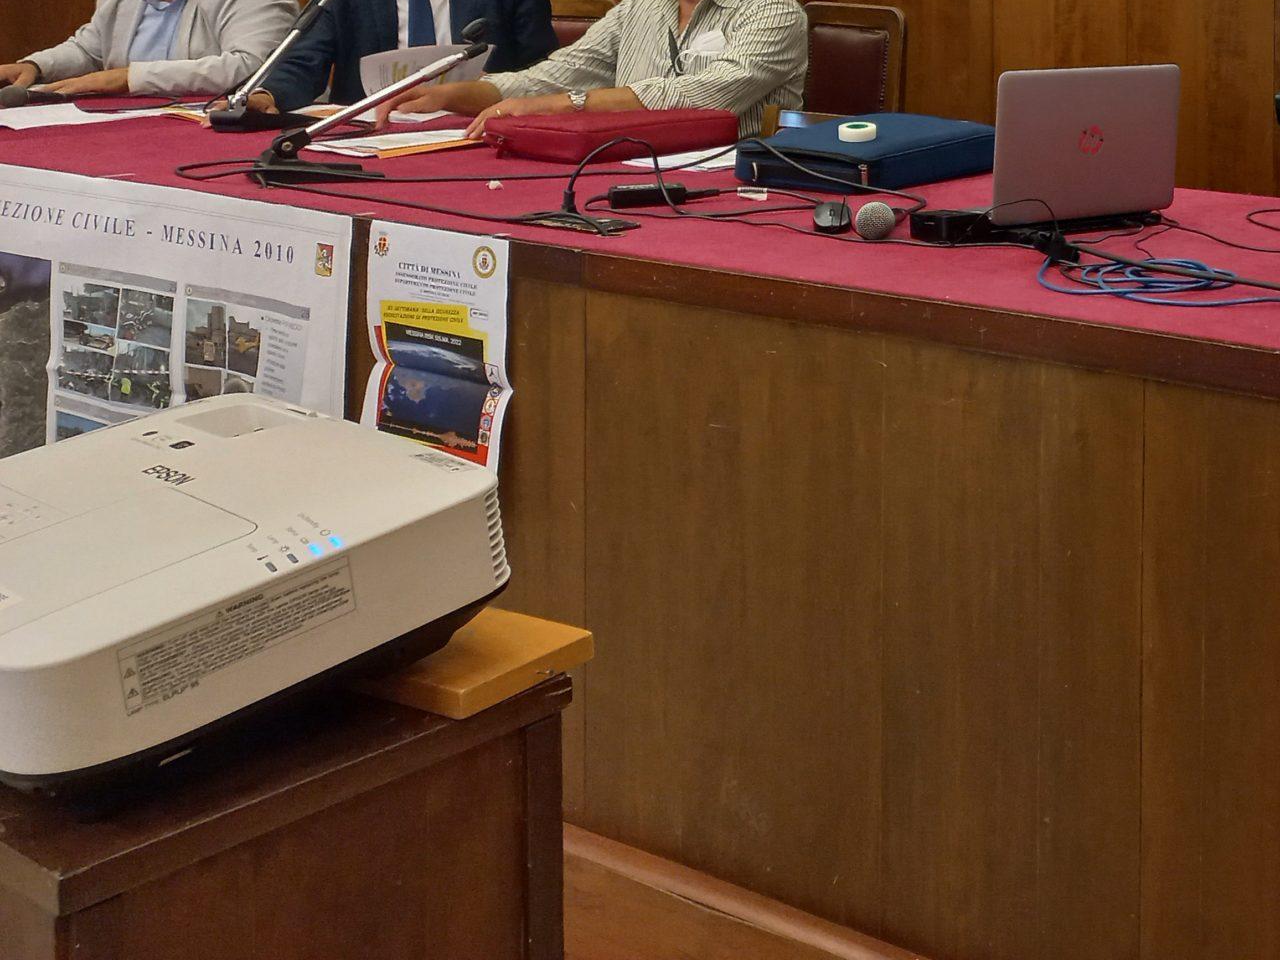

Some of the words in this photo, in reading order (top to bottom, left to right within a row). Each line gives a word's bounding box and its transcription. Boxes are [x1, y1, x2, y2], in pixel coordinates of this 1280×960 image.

[0, 200, 66, 226] EZIONE
[72, 211, 136, 237] CIVILE
[160, 224, 243, 255] MESSINA
[253, 240, 295, 264] 2010
[420, 265, 429, 274] DI
[430, 266, 461, 279] MESSINA
[141, 464, 197, 486] EPSON
